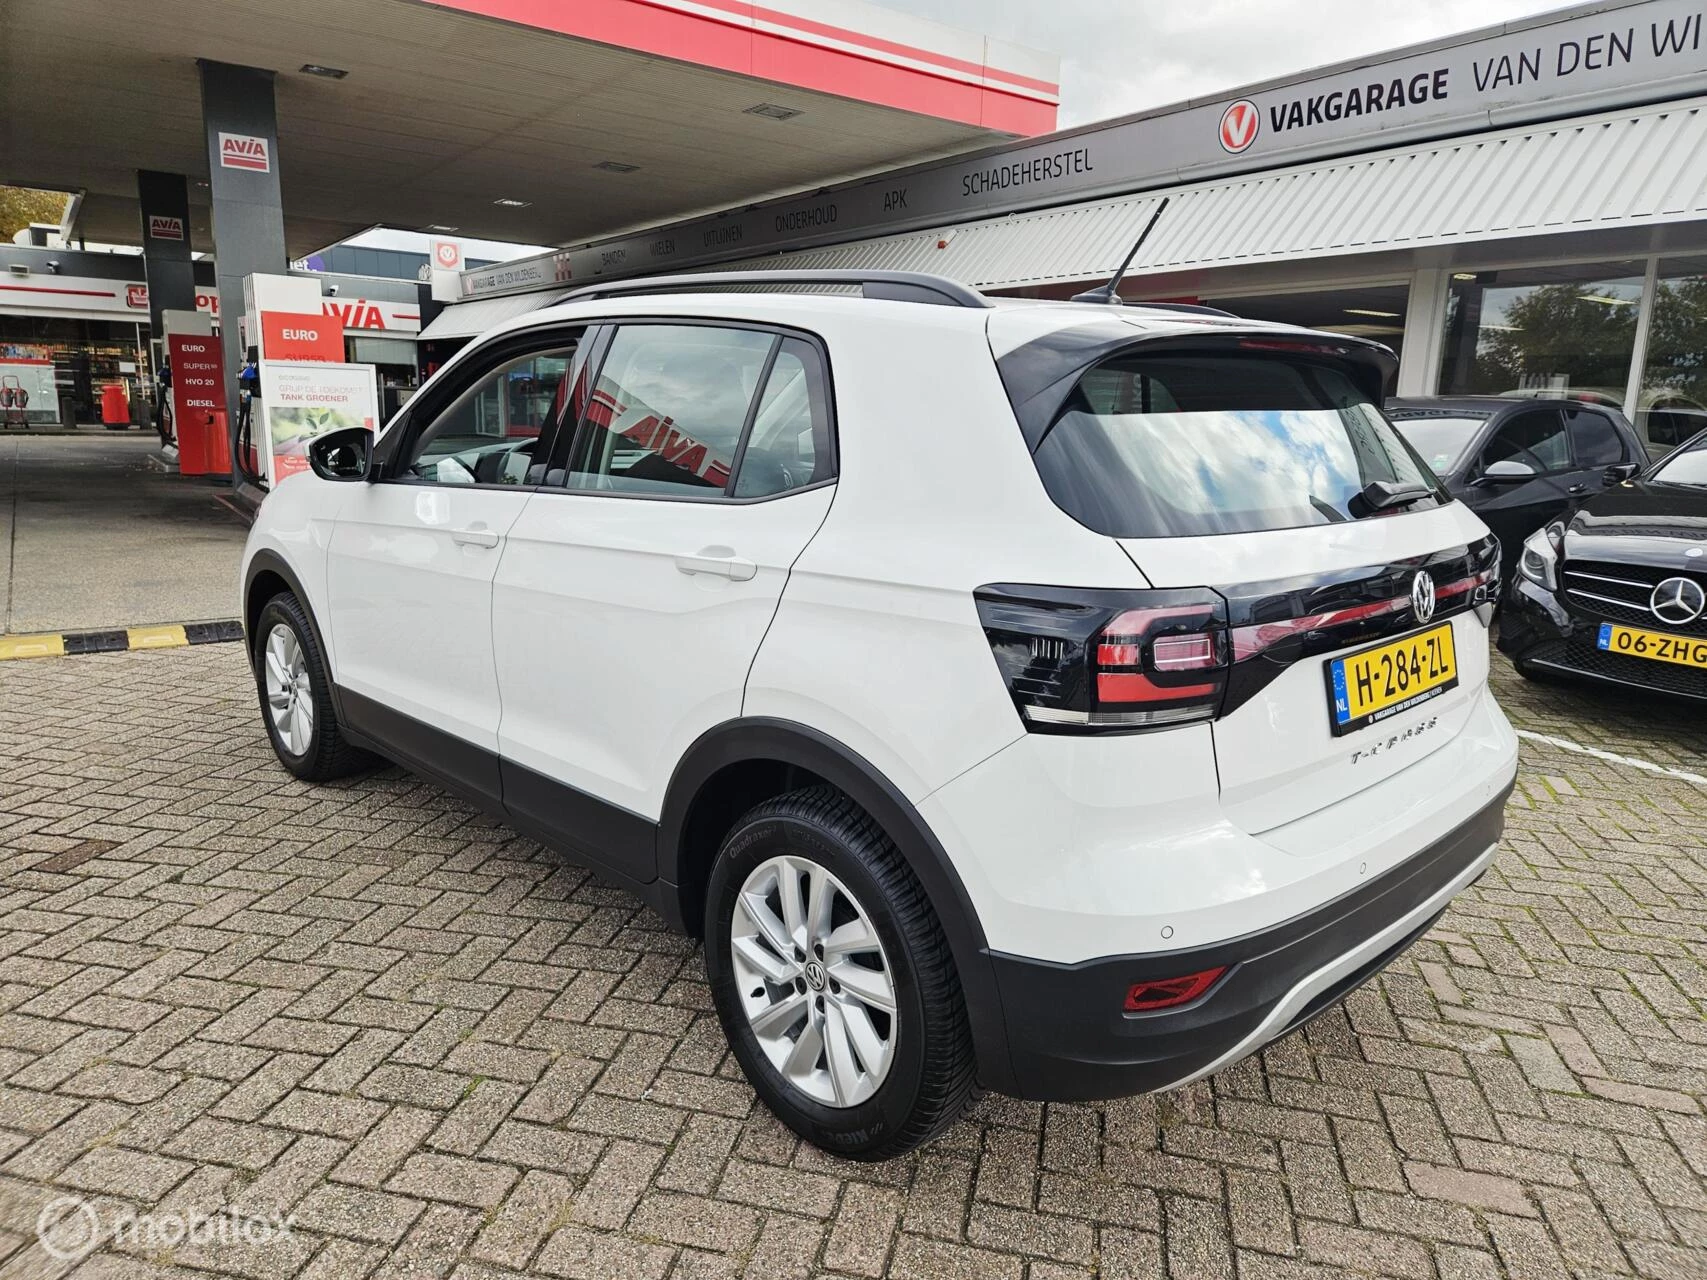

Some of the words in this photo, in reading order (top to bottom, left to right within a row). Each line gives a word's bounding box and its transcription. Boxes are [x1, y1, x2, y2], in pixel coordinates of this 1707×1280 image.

[1270, 68, 1449, 133] VAKGARAGE
[1473, 48, 1541, 92] VAN
[1556, 28, 1634, 77] DEN
[223, 138, 266, 156] AVIA
[962, 148, 1094, 197] SCHADEHERSTEL
[883, 188, 908, 212] APK
[152, 218, 181, 230] AVIA
[775, 204, 838, 233] ONDERHOUD
[282, 328, 318, 342] EURO
[181, 344, 206, 352] EURO
[186, 399, 215, 407] DIESEL
[1355, 635, 1449, 707] H-284-ZL
[1336, 698, 1348, 713] NL
